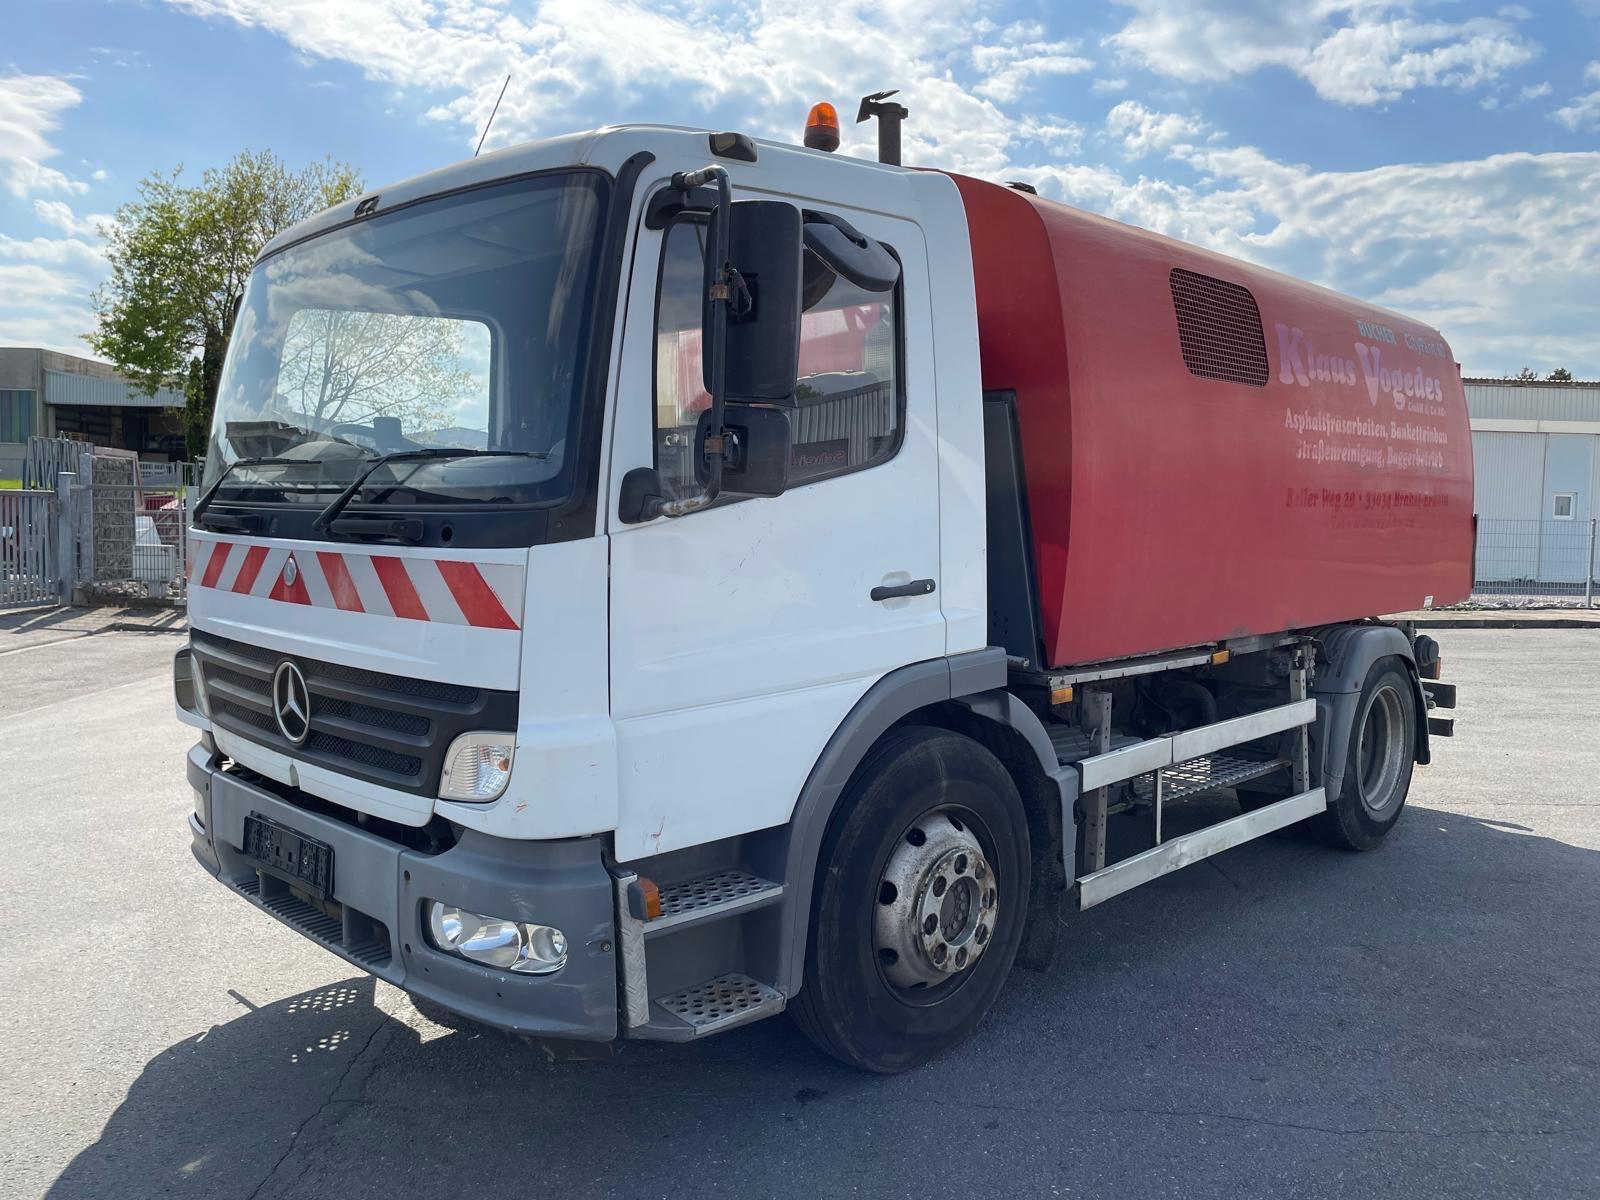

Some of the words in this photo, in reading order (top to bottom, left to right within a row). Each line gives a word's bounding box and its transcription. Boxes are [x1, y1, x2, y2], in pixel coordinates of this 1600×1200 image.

[1274, 323, 1357, 388] Klaus
[1354, 342, 1443, 411] Vogedes
[1321, 487, 1341, 513] Weg
